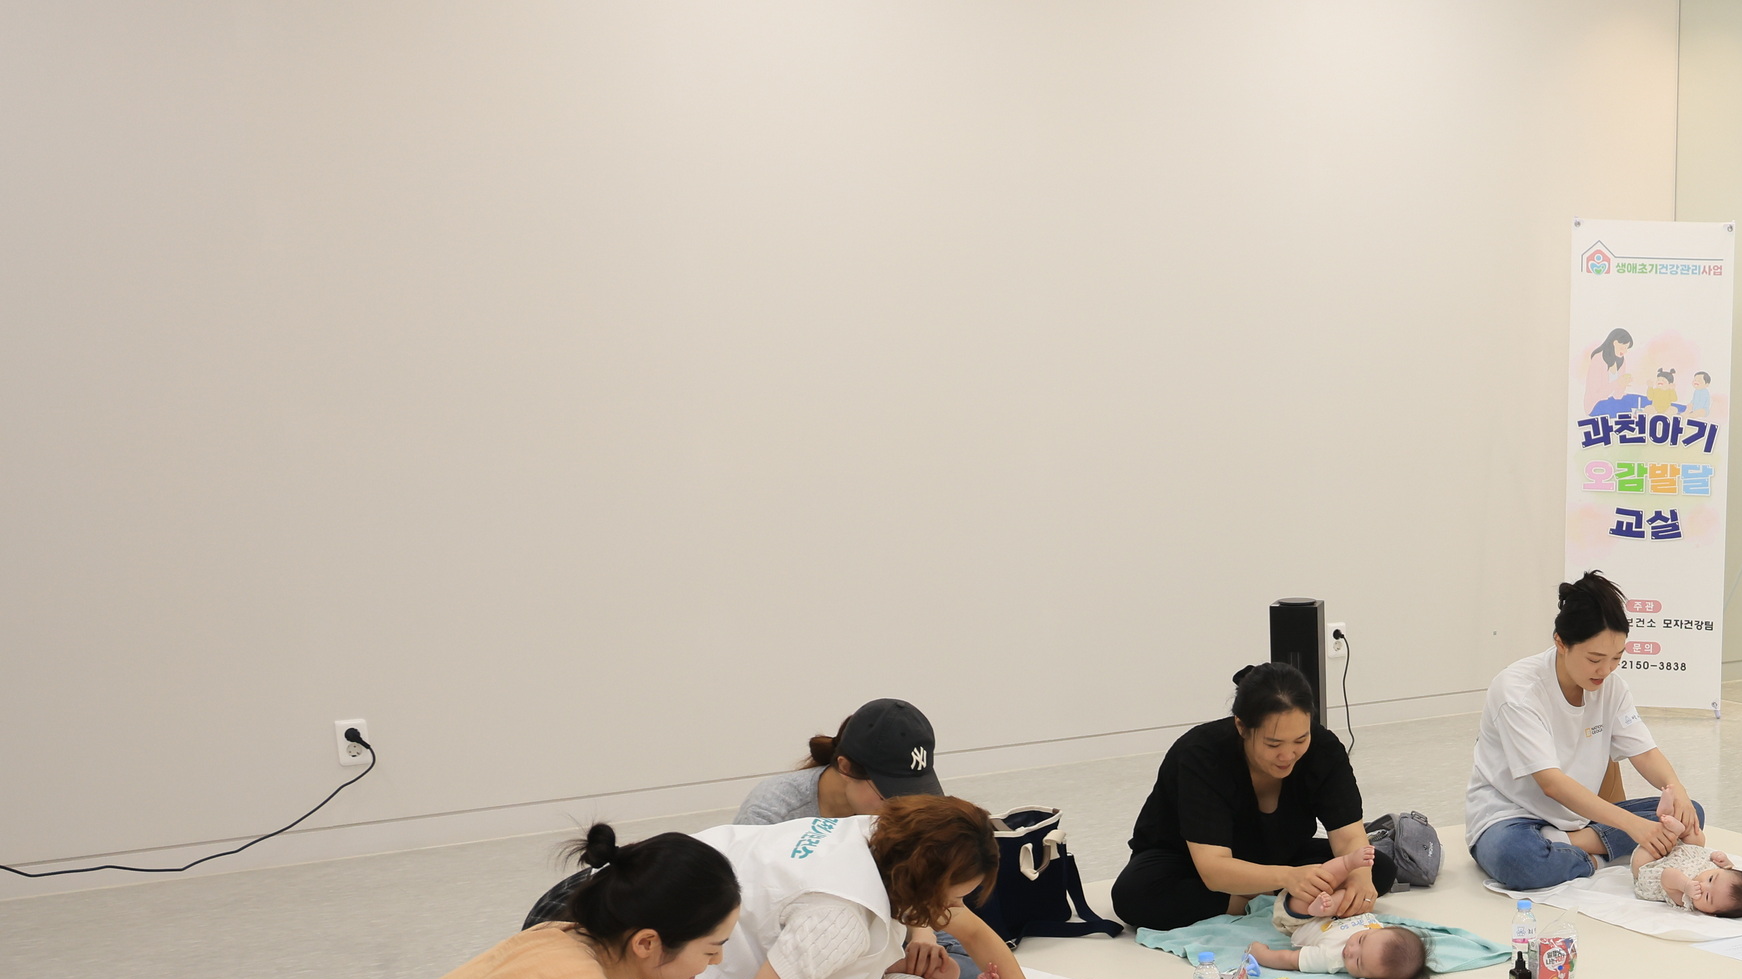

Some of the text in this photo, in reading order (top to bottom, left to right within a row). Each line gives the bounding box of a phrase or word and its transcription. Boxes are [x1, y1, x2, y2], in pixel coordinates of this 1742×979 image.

[1615, 262, 1723, 276] 생애초기건강관리사업
[1577, 413, 1719, 453] 과천아기
[1582, 461, 1714, 495] 오감발달
[1609, 507, 1682, 540] 교실
[1633, 601, 1654, 612] 주관
[1662, 619, 1714, 631] 모자건강팀
[1633, 643, 1653, 653] 문의
[1618, 660, 1687, 671] 2150-3838
[910, 746, 927, 770] NY
